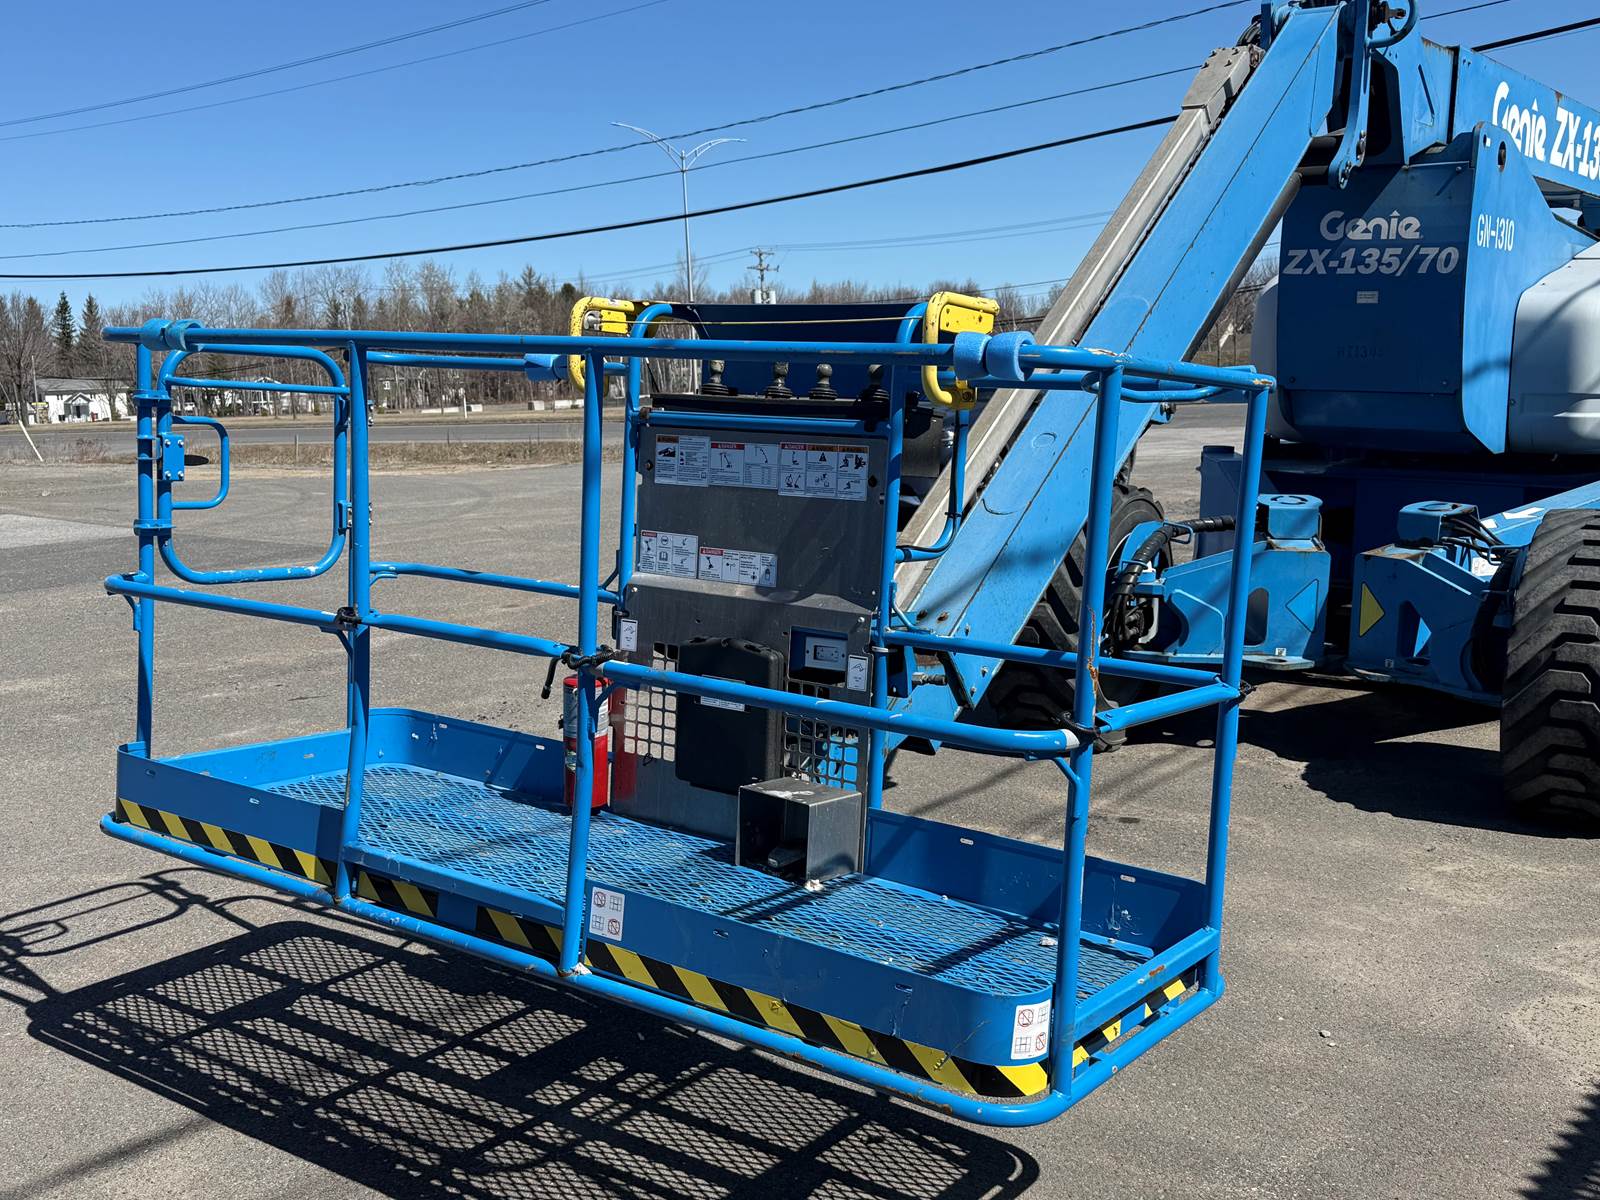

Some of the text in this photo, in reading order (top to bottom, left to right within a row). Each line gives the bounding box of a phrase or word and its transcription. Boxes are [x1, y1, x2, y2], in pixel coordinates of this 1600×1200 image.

[1492, 81, 1600, 180] Genie ZX-13
[1320, 210, 1421, 241] Genie
[1477, 213, 1515, 251] GN-1310
[1283, 245, 1460, 276] ZX-135/70
